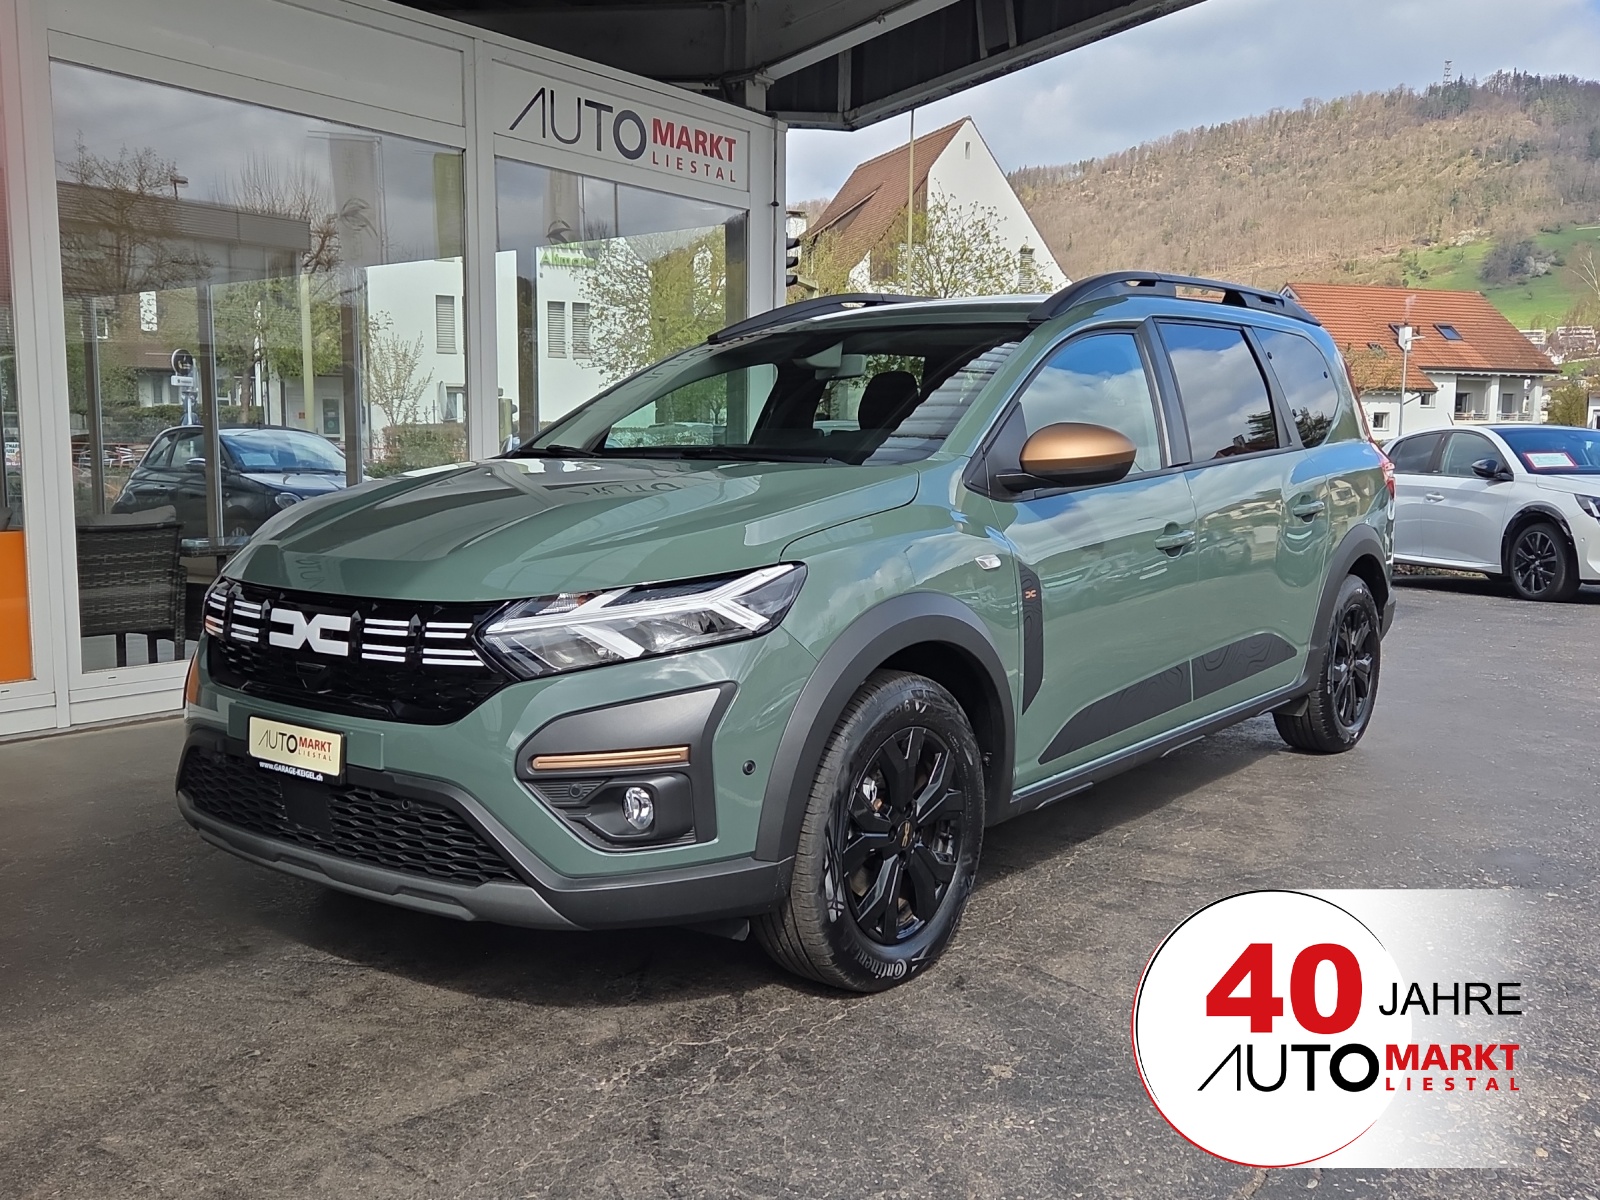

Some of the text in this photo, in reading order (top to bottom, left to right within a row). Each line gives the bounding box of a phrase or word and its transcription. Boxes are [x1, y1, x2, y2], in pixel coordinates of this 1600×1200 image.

[652, 118, 737, 162] MARKT
[652, 151, 736, 183] LIESTAL
[298, 750, 332, 762] LIESTAL
[299, 736, 332, 753] MARKT
